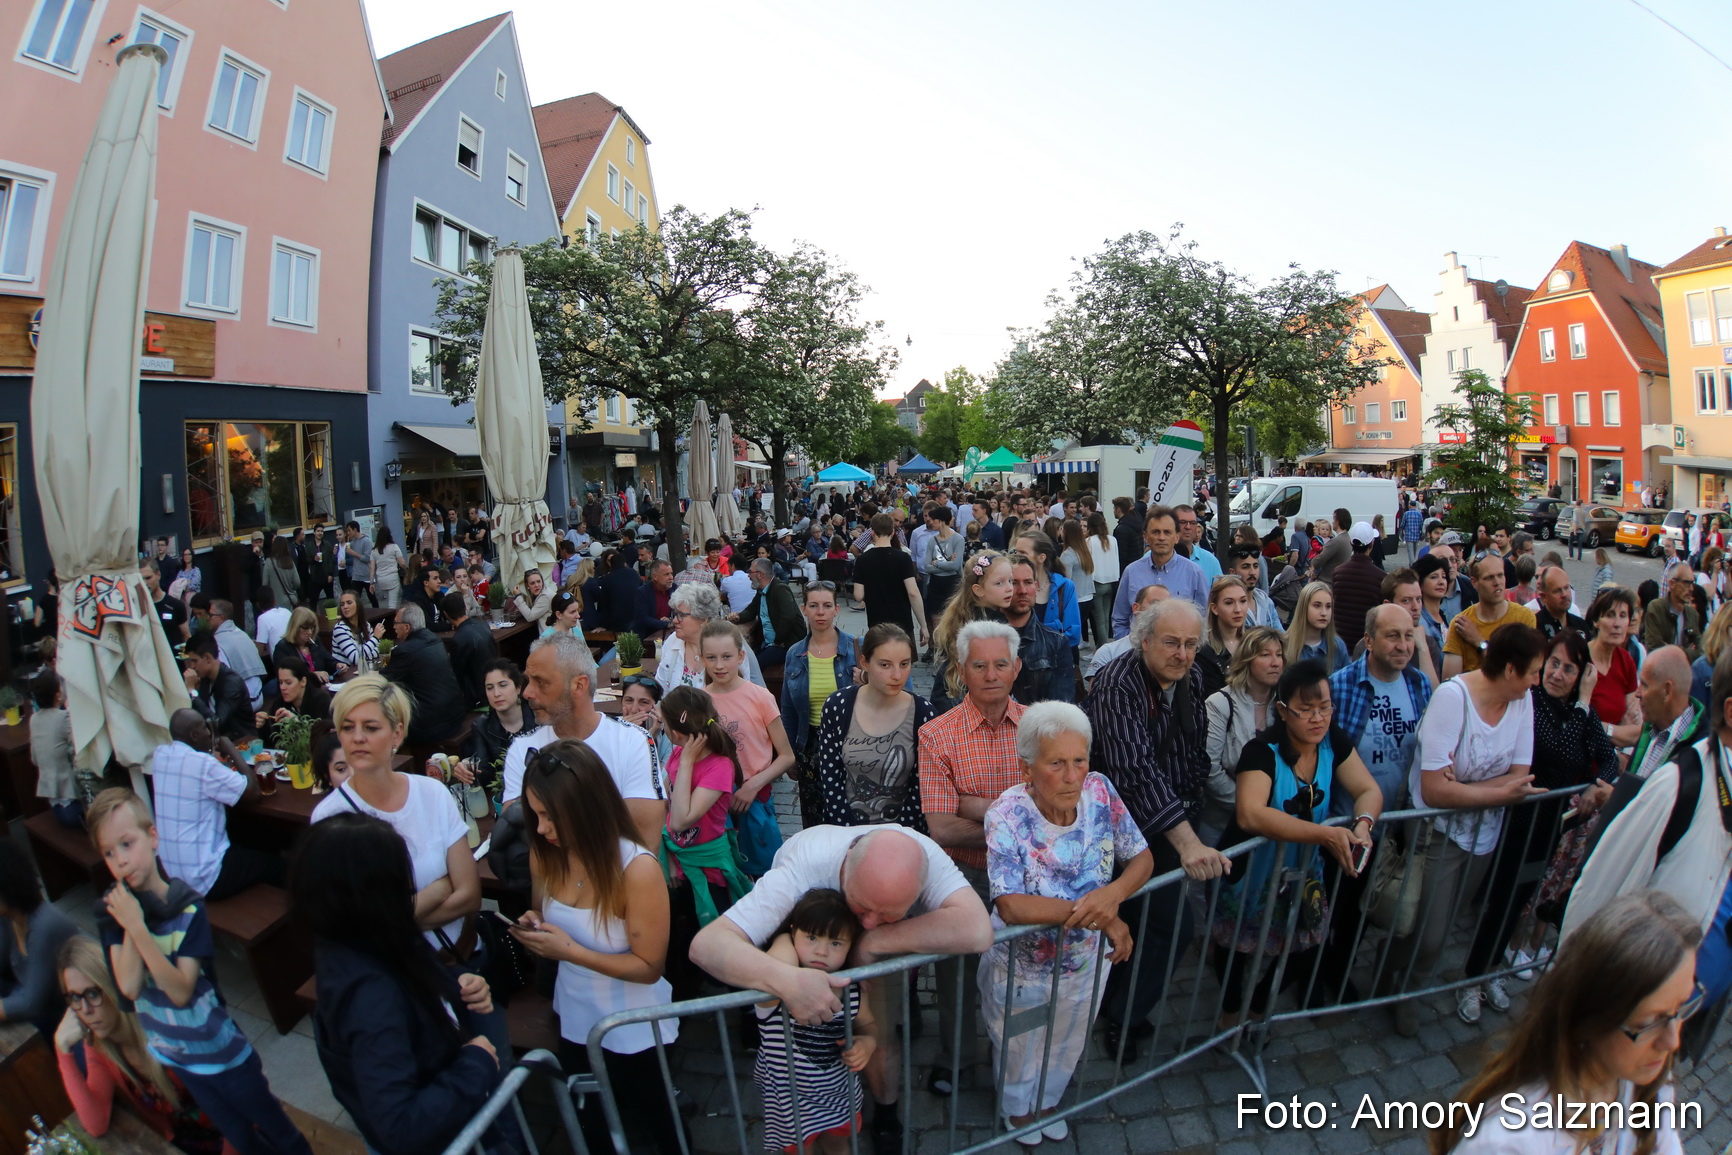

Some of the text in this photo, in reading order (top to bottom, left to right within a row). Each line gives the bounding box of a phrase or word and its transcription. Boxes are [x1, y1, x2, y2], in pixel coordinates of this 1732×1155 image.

[1153, 450, 1177, 504] LANGO
[1369, 708, 1402, 722] PME
[844, 754, 880, 773] ing
